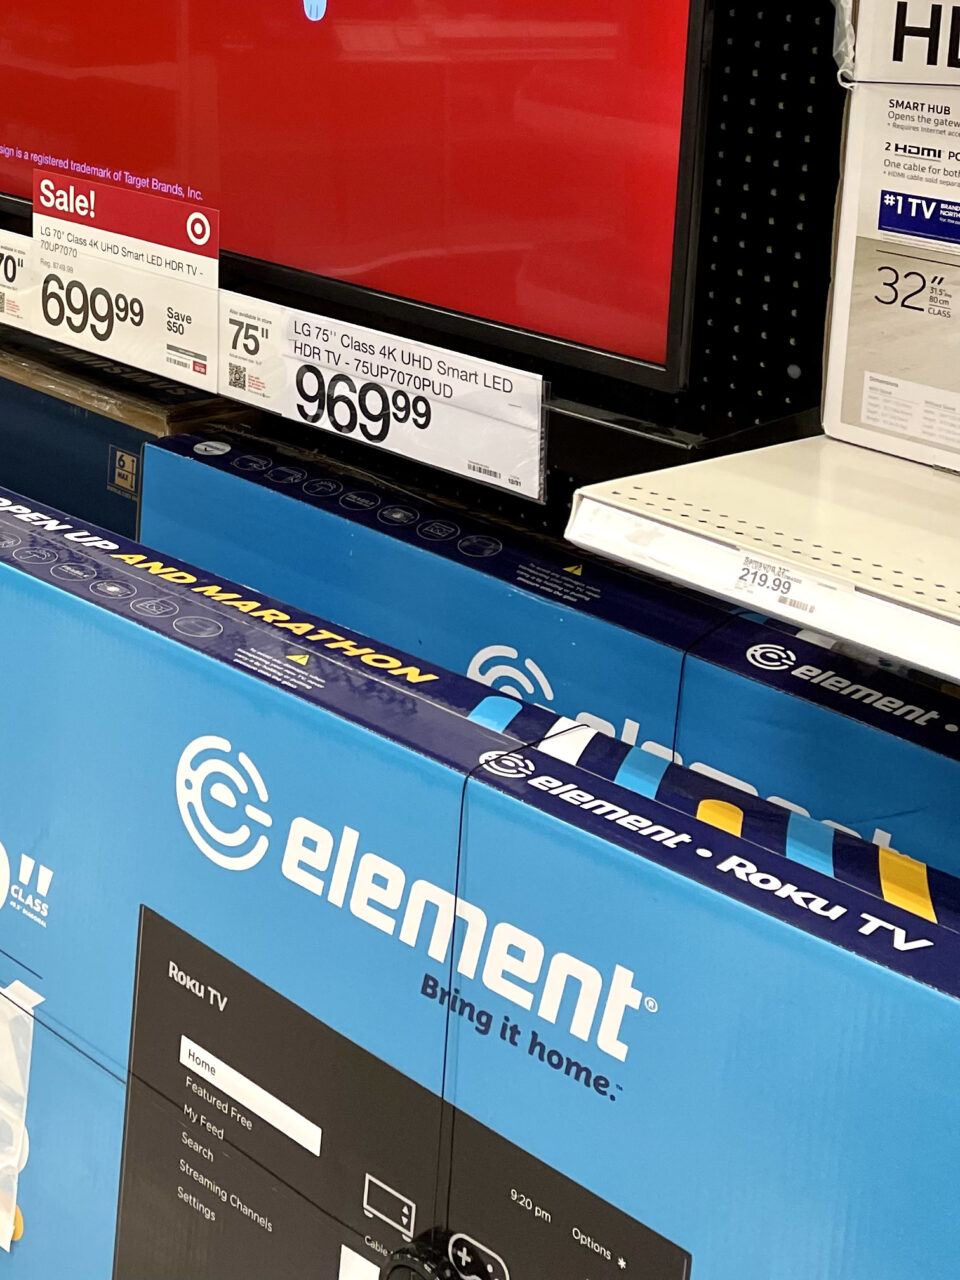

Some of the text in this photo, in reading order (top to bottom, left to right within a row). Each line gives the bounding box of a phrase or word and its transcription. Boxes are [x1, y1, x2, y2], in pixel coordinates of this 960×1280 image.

[888, 111, 932, 125] Opens the
[889, 99, 951, 115] SMART HUB
[884, 142, 942, 159] 2 HDMI
[16, 148, 22, 158] is
[30, 152, 69, 169] registered
[71, 160, 111, 180] trademark
[113, 171, 122, 182] of
[123, 172, 149, 190] Target
[151, 178, 185, 198] Brands,
[187, 186, 203, 201] Inc.
[884, 159, 941, 175] One cable for
[40, 178, 96, 218] Sale!
[884, 194, 937, 219] #1 TV
[40, 239, 78, 258] 70UP7070
[40, 226, 198, 276] LG Class 4K UHD Smart LED HDR TV
[166, 307, 192, 324] Save
[928, 307, 951, 318] CLASS
[929, 296, 950, 306] 80 cm
[166, 321, 185, 335] $50
[293, 341, 454, 399] HDR TV 75UP7070PUD
[294, 320, 514, 394] LG Class 4K UHD Smart LED
[117, 454, 126, 469] 6
[738, 567, 792, 595] 219.99
[64, 531, 119, 551] UP
[109, 554, 198, 585] AND
[191, 584, 440, 686] MARATHON
[791, 662, 941, 729] element
[527, 772, 692, 851] element
[858, 912, 935, 953] TV
[10, 884, 49, 917] CLASS
[207, 985, 228, 1012] TV
[421, 972, 492, 1037] Bring
[501, 1011, 521, 1048] it
[188, 1048, 216, 1076] Home
[185, 1076, 253, 1131] Featured Free
[183, 1104, 224, 1141] My Feed
[181, 1131, 214, 1162] Search
[177, 1186, 216, 1222] Settings
[179, 1159, 273, 1233] Streaming Channels
[510, 1188, 552, 1223] 9:20 pm
[364, 1235, 388, 1258] Cable
[572, 1227, 612, 1261] Options
